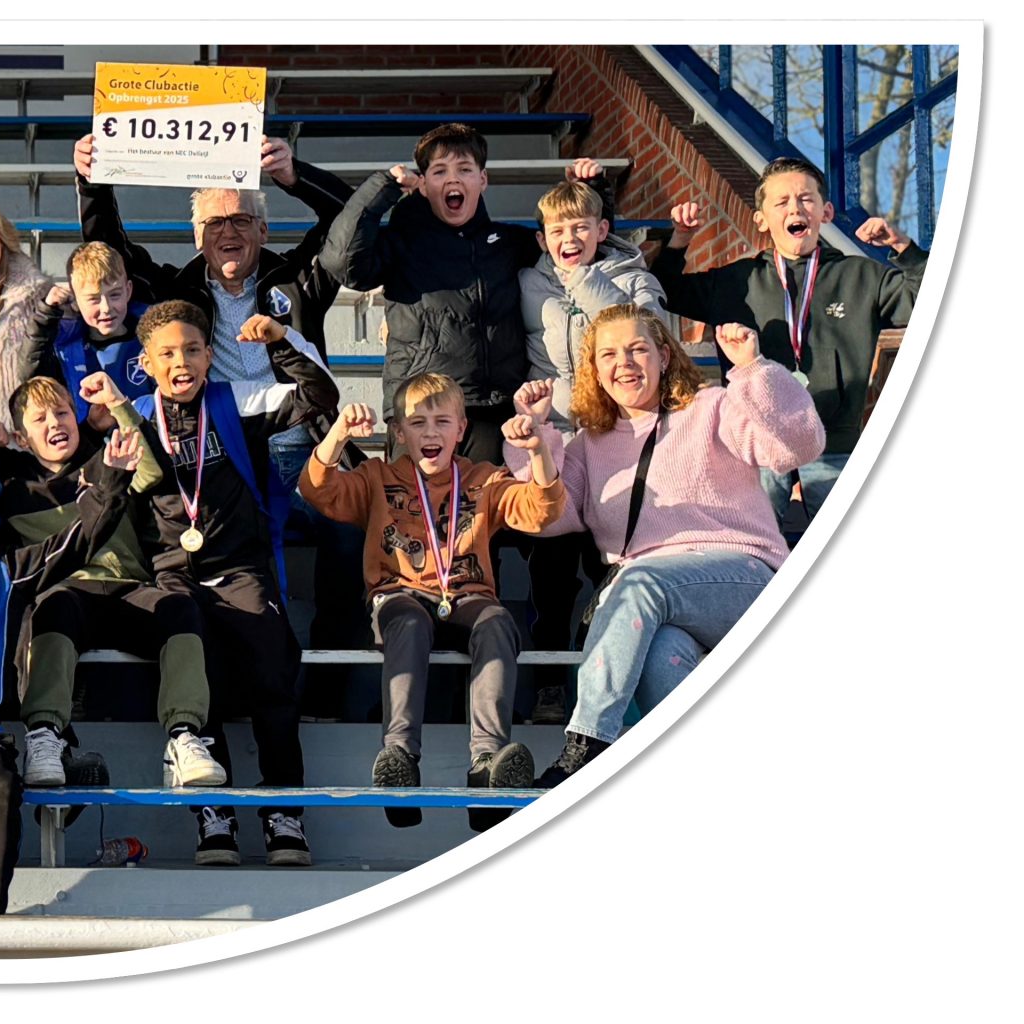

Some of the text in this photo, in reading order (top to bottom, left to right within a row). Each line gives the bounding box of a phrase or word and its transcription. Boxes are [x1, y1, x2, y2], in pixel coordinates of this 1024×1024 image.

[109, 78, 200, 92] Grote Clubactie
[108, 92, 189, 105] Opbrengst 2025
[102, 117, 249, 146] € 10.312,91
